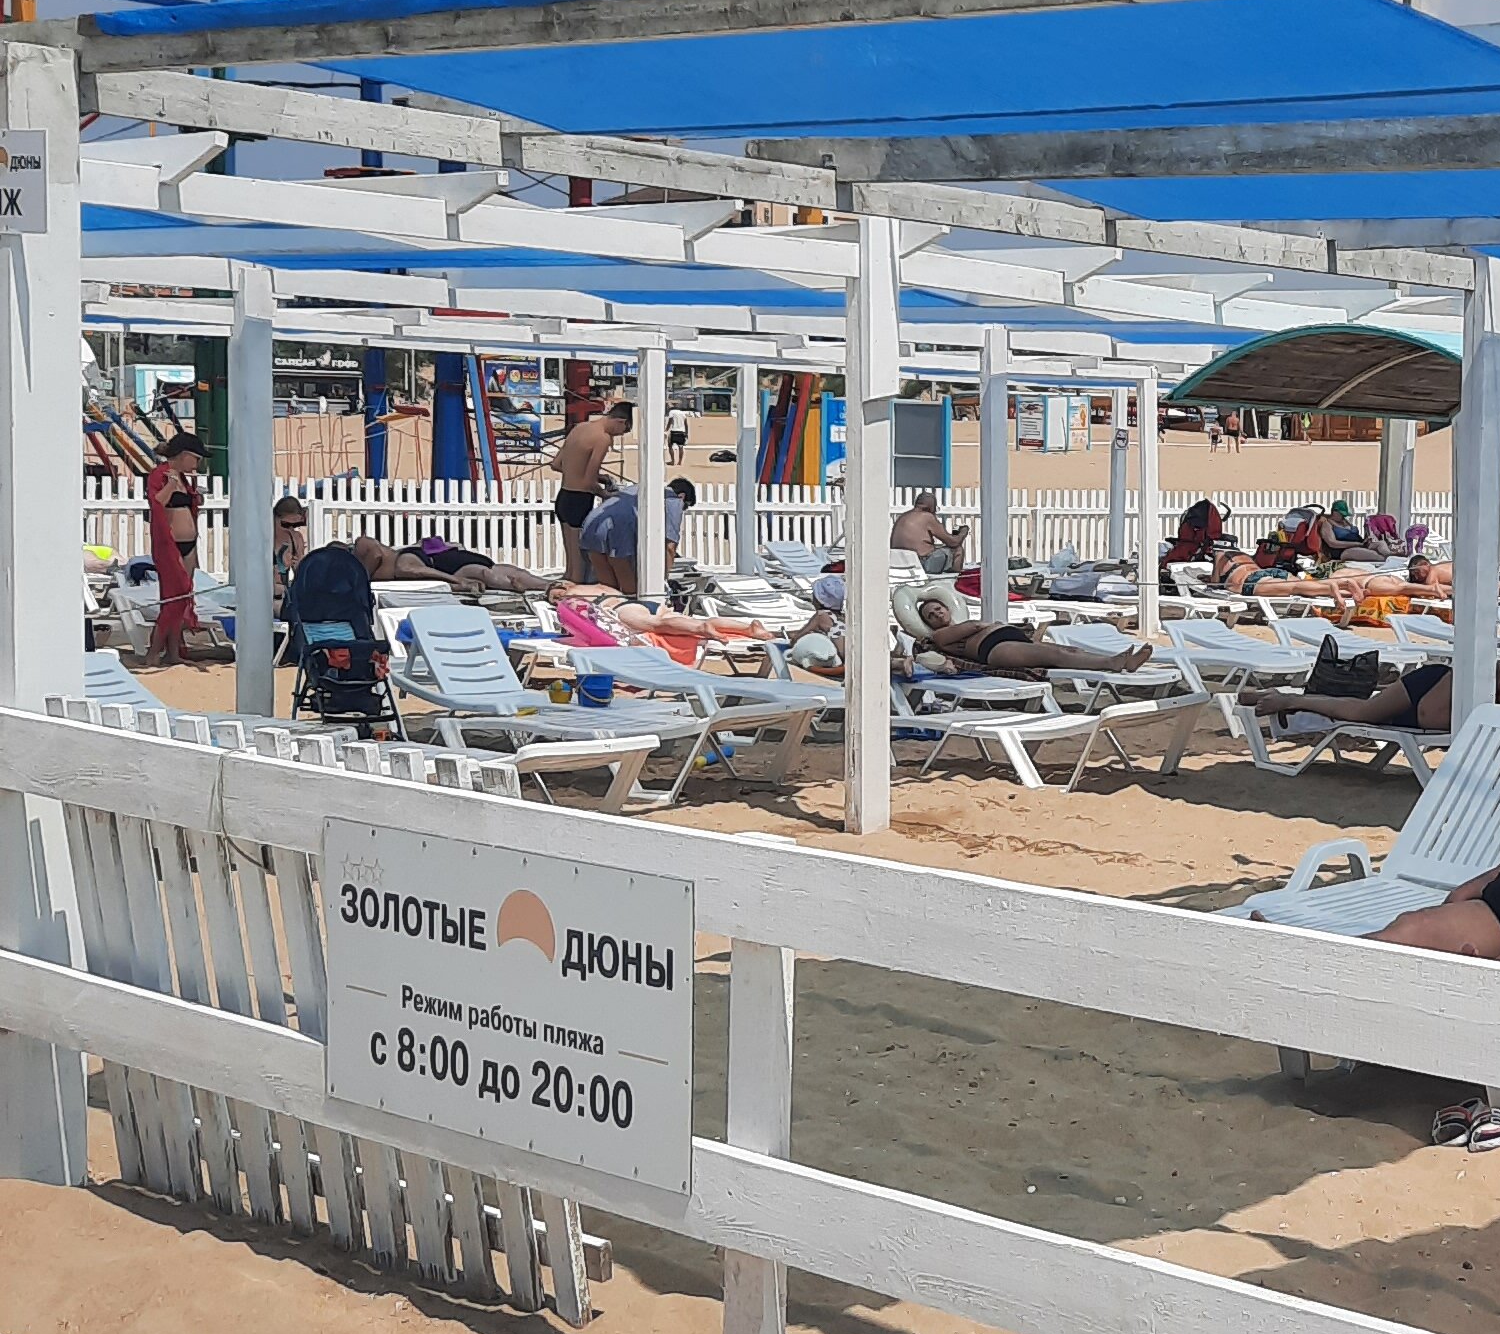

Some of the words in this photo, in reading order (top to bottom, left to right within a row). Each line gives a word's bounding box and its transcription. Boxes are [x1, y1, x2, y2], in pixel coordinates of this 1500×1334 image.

[340, 883, 487, 951] ЗОЛОТЫЕ
[561, 928, 674, 992] ДЮНЫ
[401, 984, 463, 1022] Режим
[468, 1004, 537, 1040] работы
[543, 1023, 604, 1056] пляжа
[370, 1031, 387, 1066] с
[397, 1027, 469, 1087] 8:00
[478, 1059, 520, 1104] до
[531, 1060, 633, 1129] 20:00
